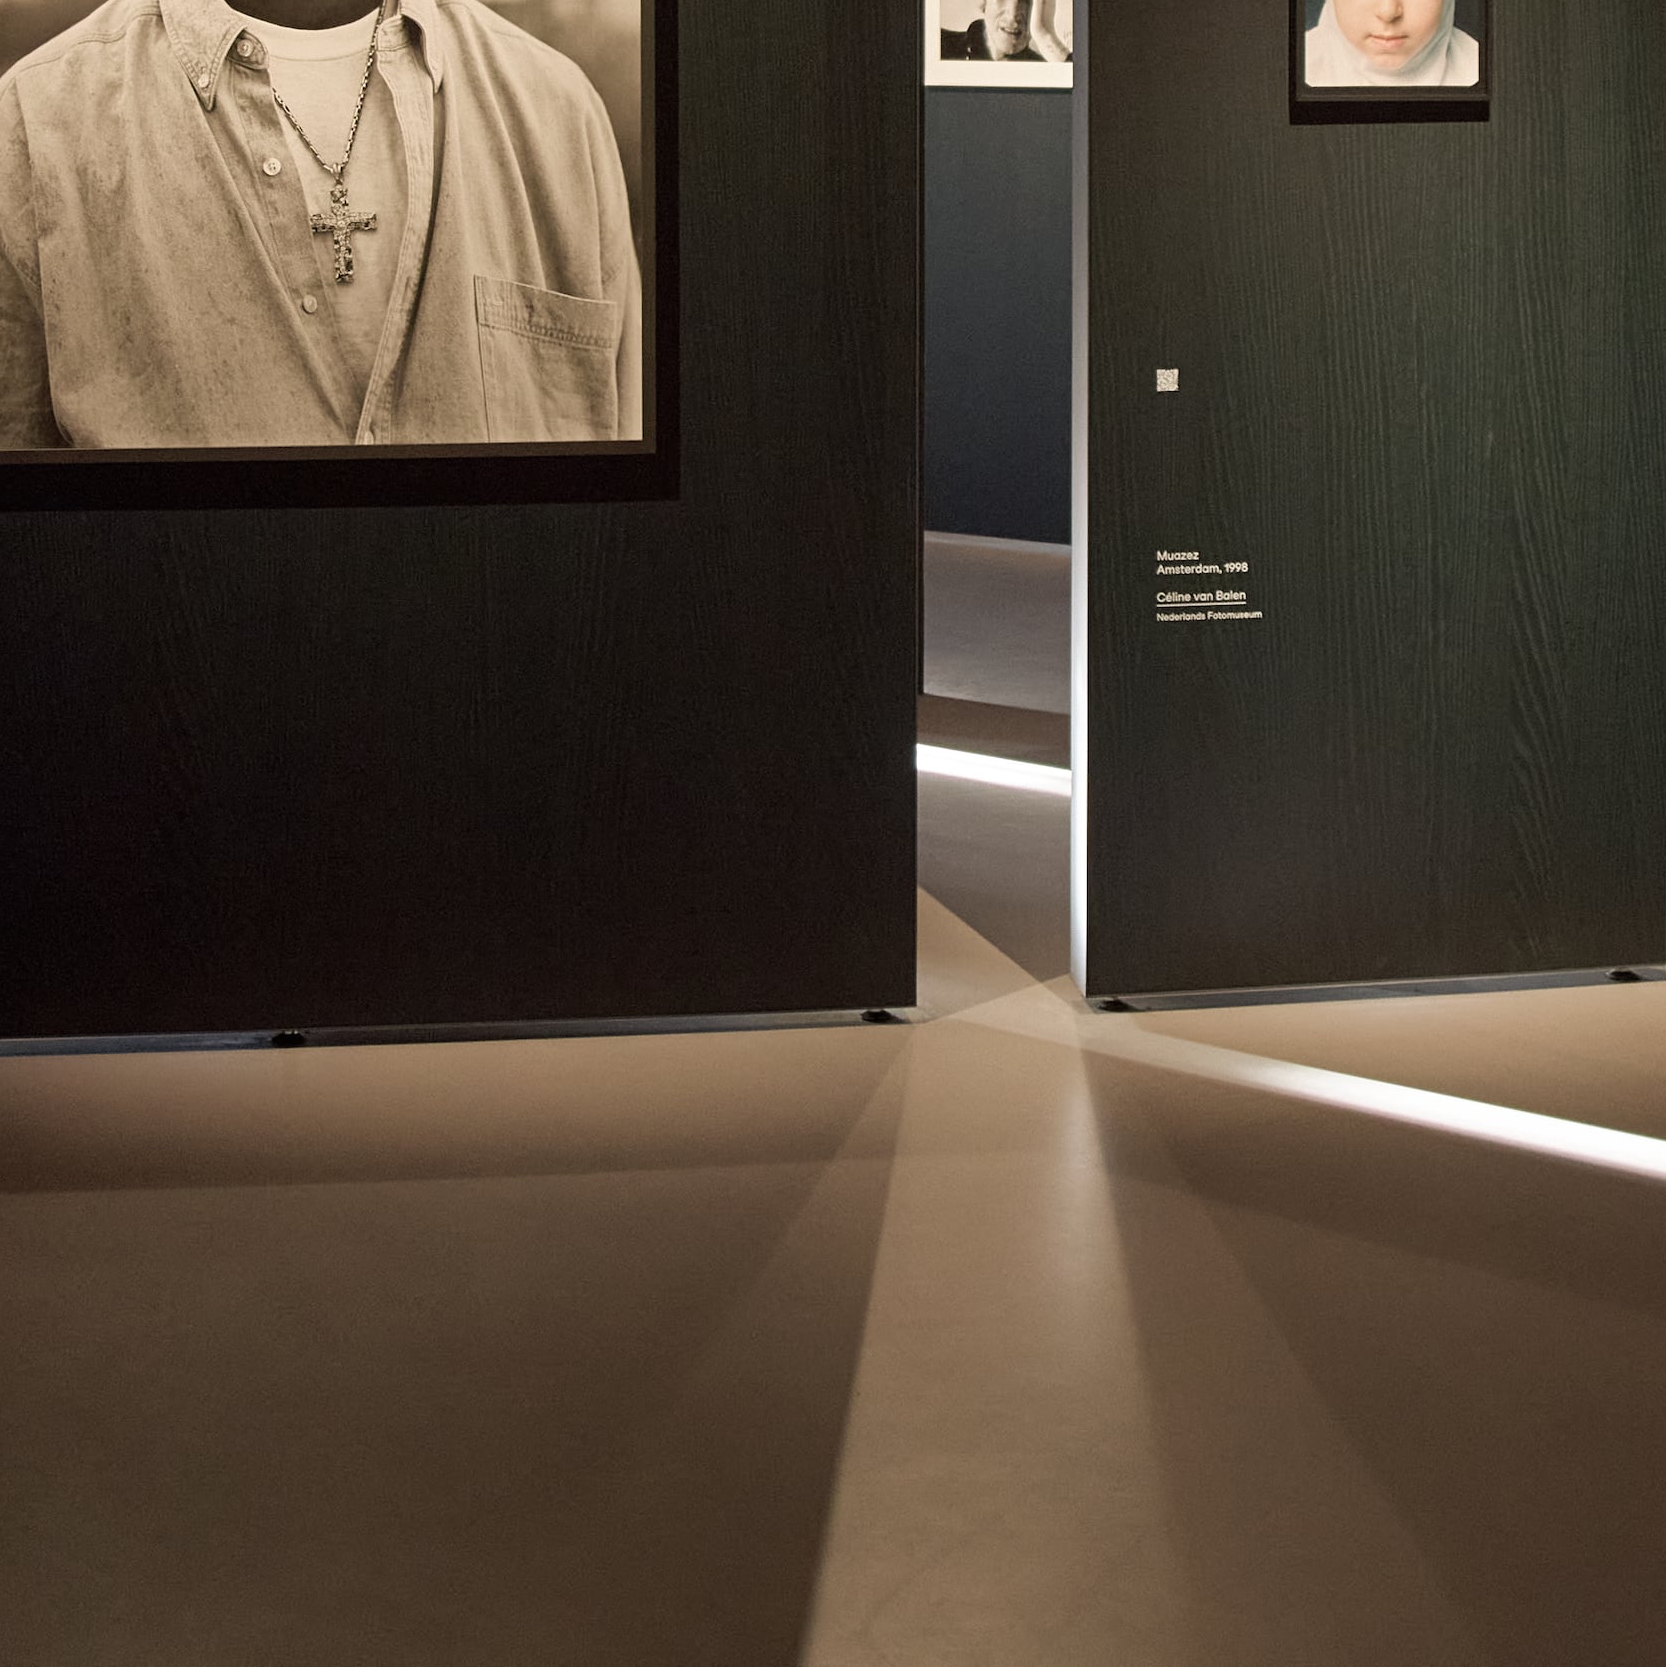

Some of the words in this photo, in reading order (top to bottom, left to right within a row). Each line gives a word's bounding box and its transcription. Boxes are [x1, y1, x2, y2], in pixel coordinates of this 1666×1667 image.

[1156, 550, 1199, 561] Muazez
[1156, 563, 1223, 575] Amsterdam,
[1224, 562, 1249, 573] 1998
[1156, 591, 1191, 603] Céline
[1193, 593, 1213, 602] van
[1215, 590, 1247, 601] Balen
[1156, 612, 1206, 622] Nederlands
[1207, 611, 1263, 621] Fotomuseum
